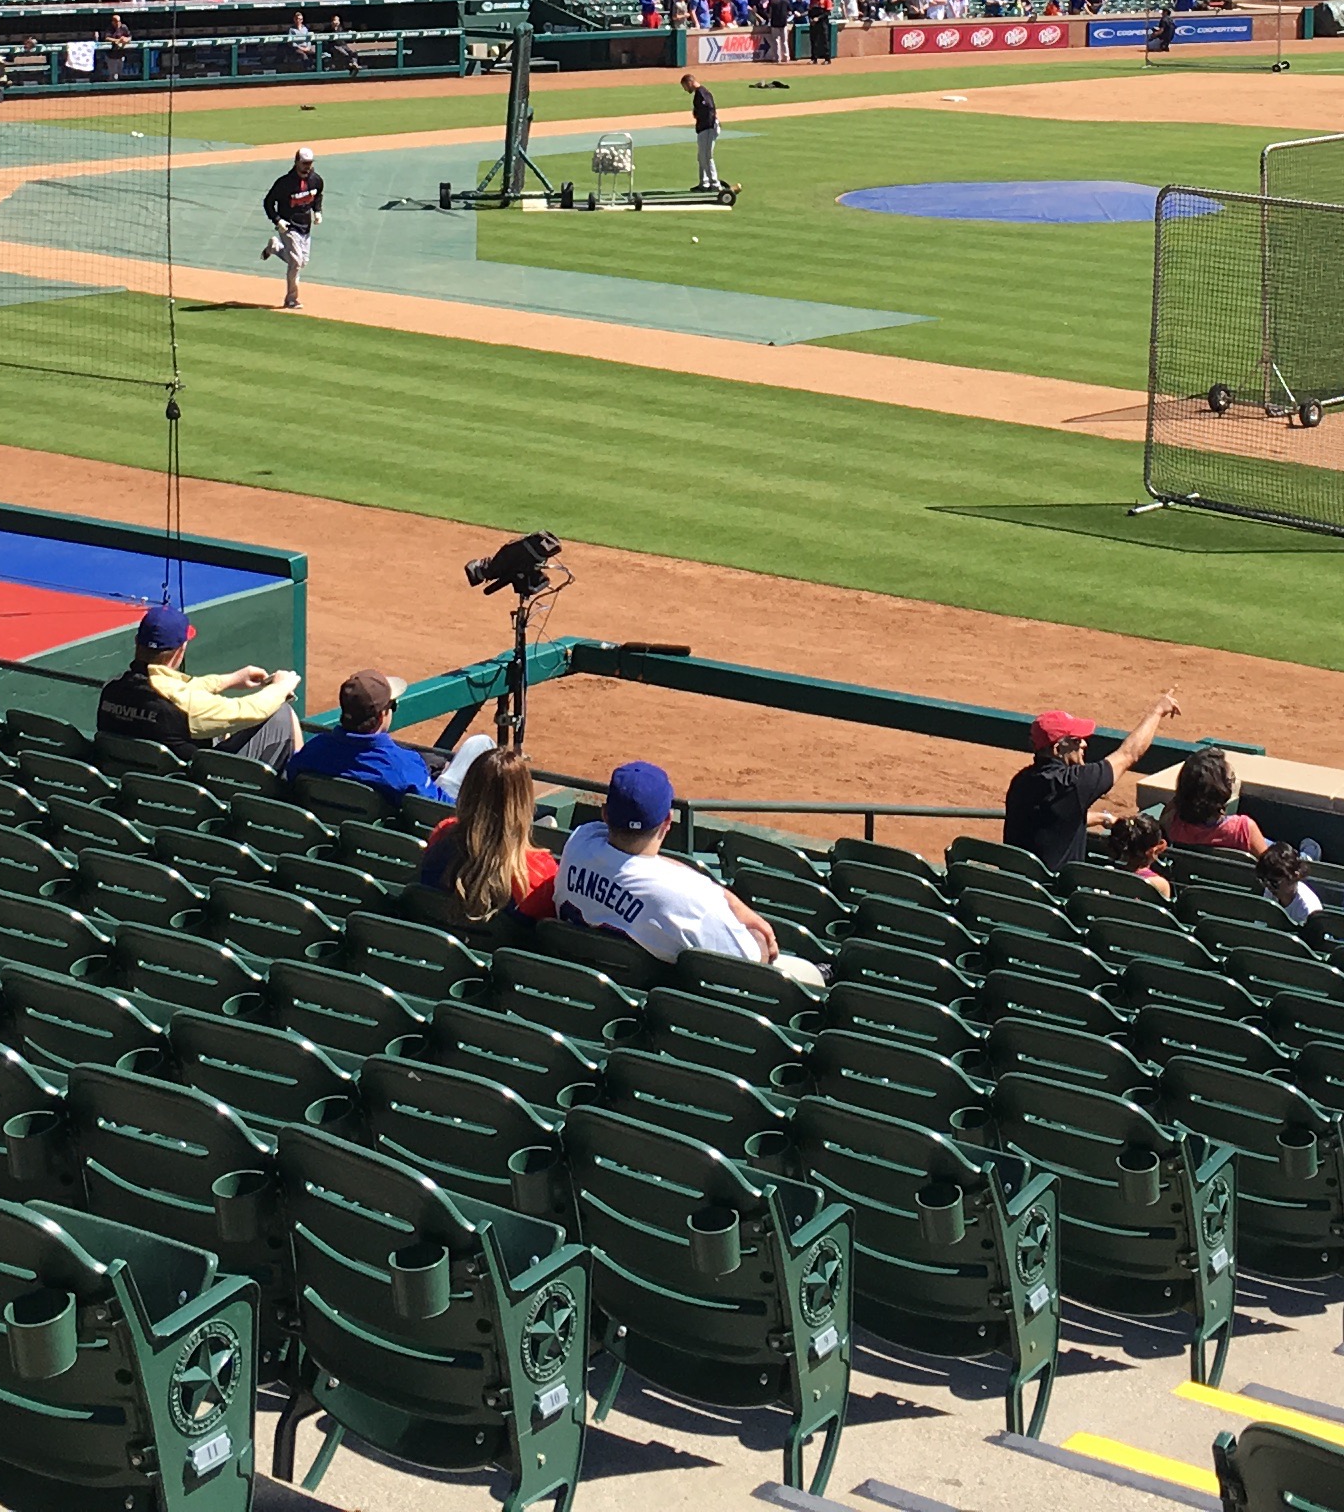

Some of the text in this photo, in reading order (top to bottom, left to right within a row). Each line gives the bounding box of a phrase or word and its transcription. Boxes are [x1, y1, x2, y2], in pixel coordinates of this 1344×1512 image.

[722, 34, 762, 52] ARROW
[567, 864, 645, 924] CANSECO
[549, 1391, 561, 1407] 10
[206, 1442, 220, 1461] 11
